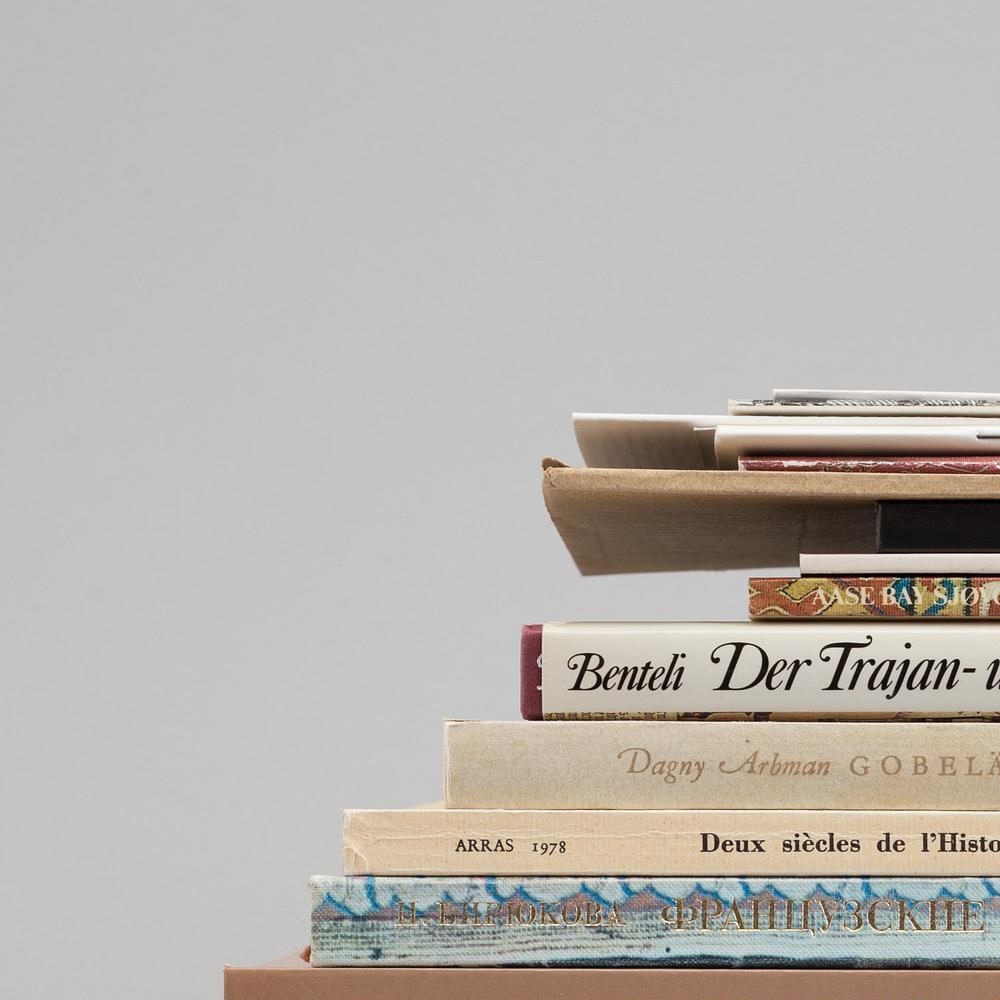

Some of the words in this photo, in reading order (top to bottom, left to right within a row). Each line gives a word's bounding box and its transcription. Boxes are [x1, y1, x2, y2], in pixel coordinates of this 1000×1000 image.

[812, 587, 874, 606] AASE
[881, 587, 926, 606] BAY
[567, 652, 687, 691] Benteli
[711, 642, 812, 691] Der
[819, 634, 977, 700] Trajan-
[617, 746, 705, 785] Dagny
[718, 748, 830, 778] Arbman
[455, 838, 514, 853] ARRAS
[531, 840, 567, 857] 1978
[700, 832, 765, 855] Deux
[781, 830, 862, 855] siècles
[876, 831, 906, 855] de
[661, 897, 985, 938] ФРАНЦУЗСКИЕ
